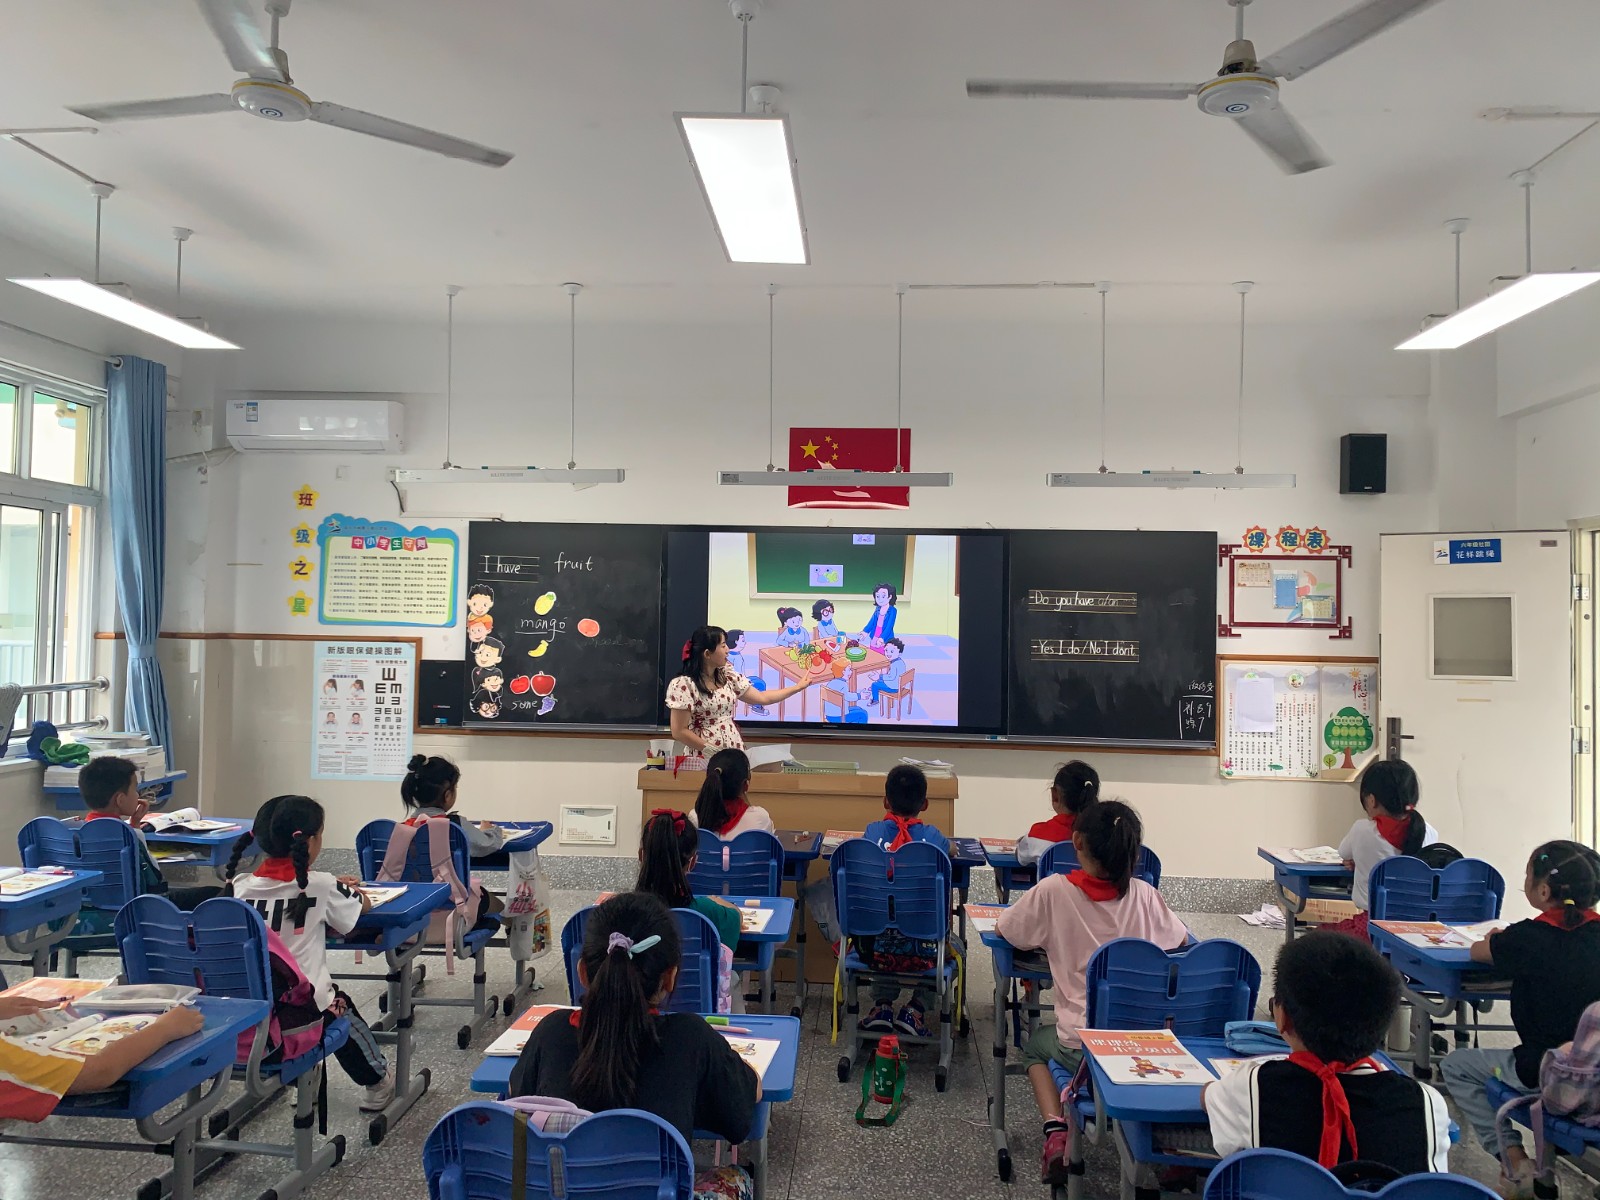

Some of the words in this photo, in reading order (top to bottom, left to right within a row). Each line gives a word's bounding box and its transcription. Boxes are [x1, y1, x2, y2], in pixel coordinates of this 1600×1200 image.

[352, 537, 428, 551] 中小学生守则
[1247, 531, 1324, 549] 课程表
[292, 493, 314, 613] 班级之星
[496, 555, 522, 574] have
[554, 551, 594, 573] fruit
[1054, 597, 1073, 611] you
[1074, 591, 1095, 606] have
[521, 616, 567, 642] mango
[327, 646, 403, 656] 新版眼保健操图解
[511, 699, 538, 711] some
